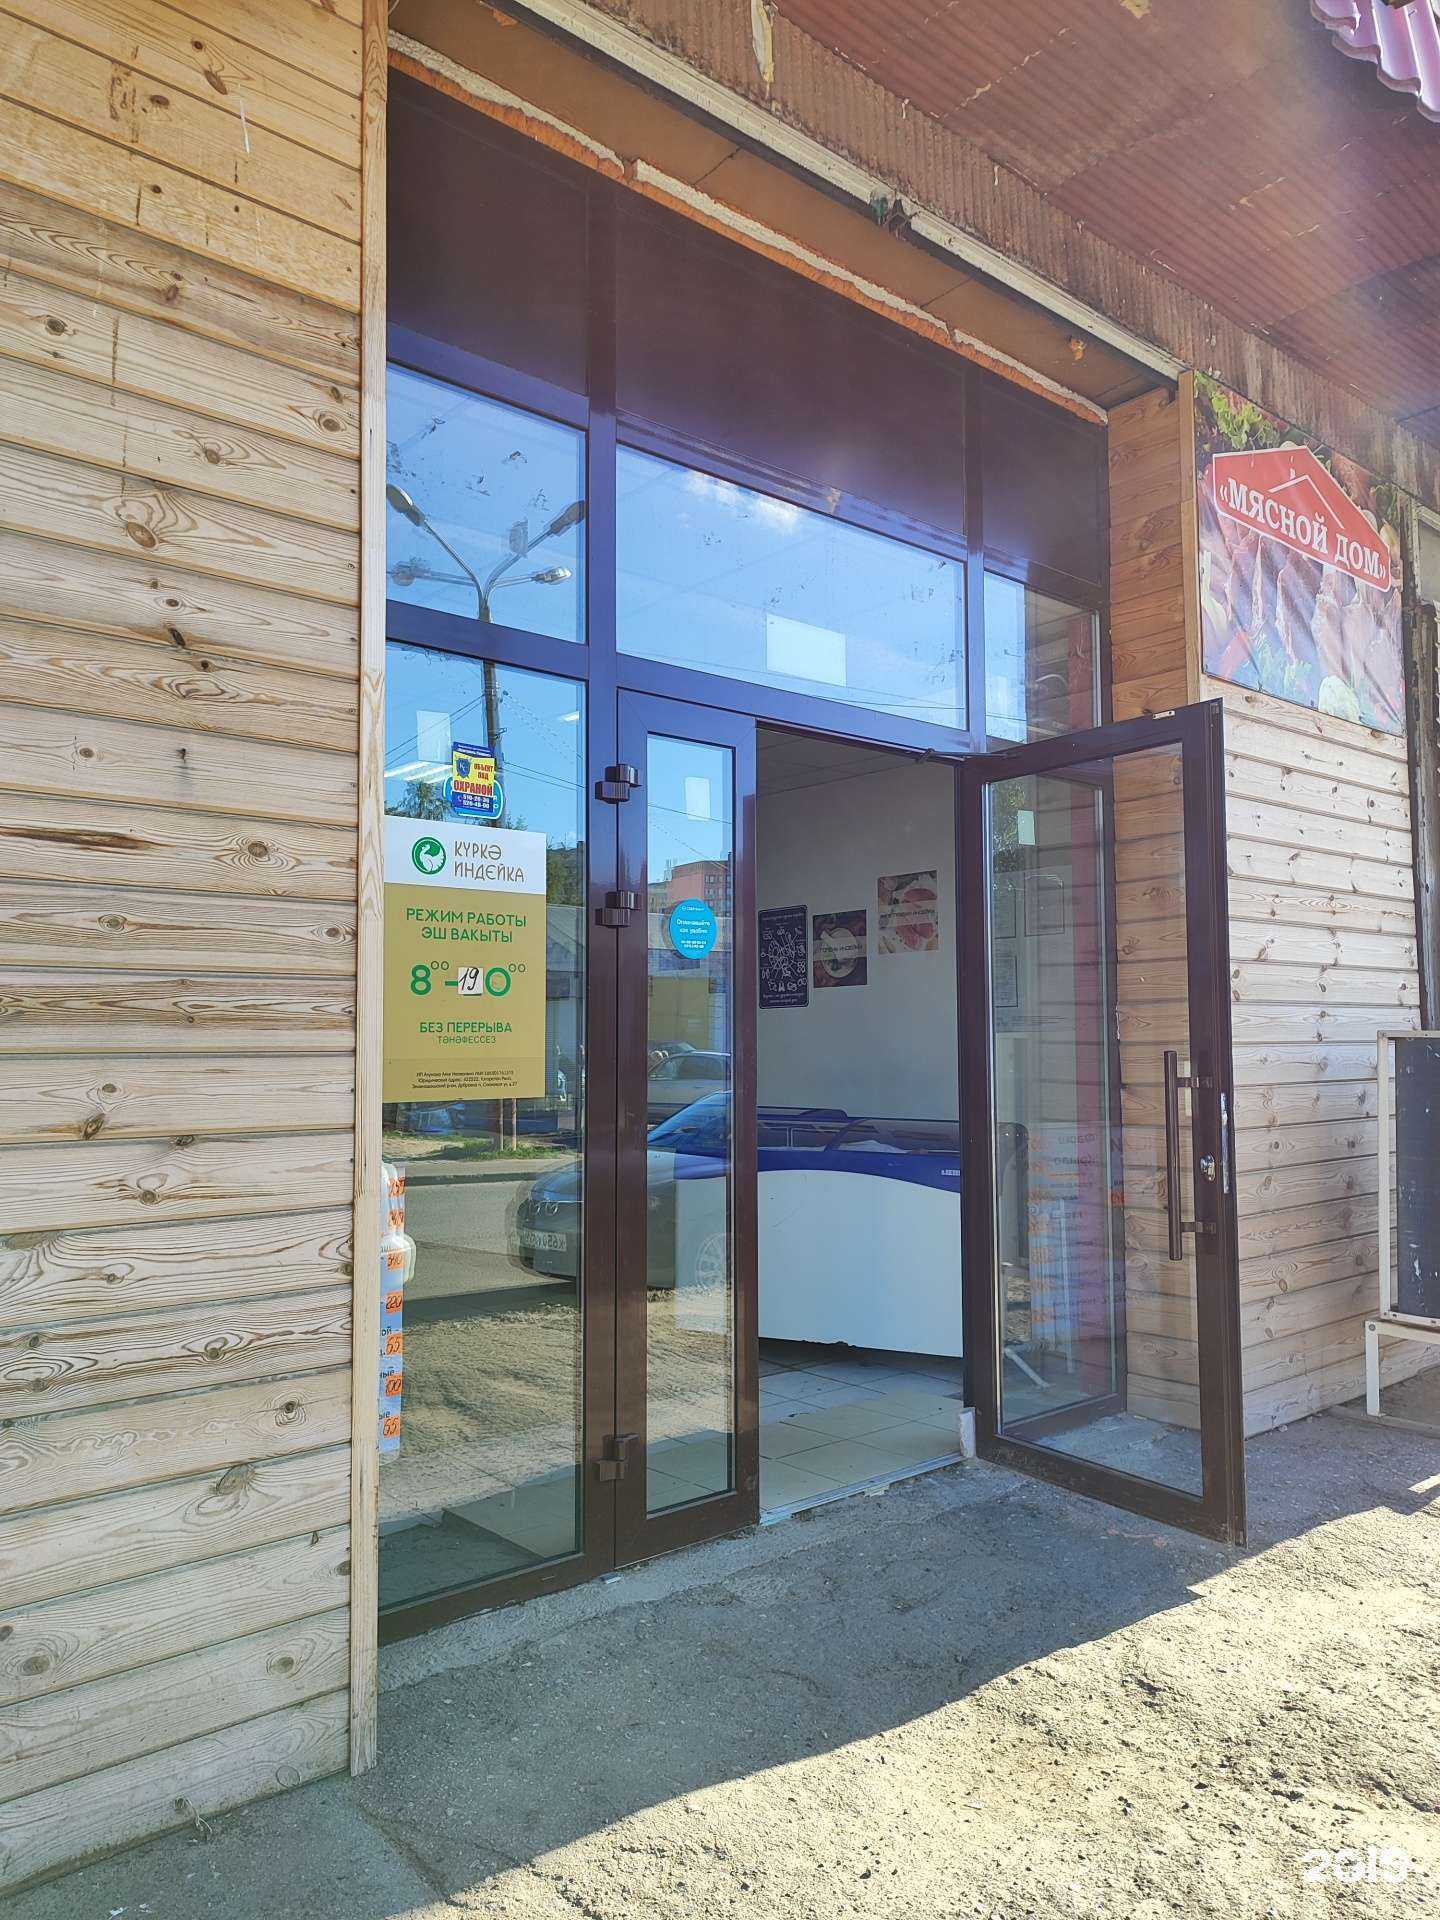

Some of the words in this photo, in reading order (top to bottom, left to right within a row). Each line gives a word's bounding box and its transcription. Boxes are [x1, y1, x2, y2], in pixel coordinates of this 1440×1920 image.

[1219, 477, 1329, 554] «МЯСНОЙ
[1335, 533, 1386, 580] ДОМ»
[453, 780, 493, 796] ОХРАНОЙ
[454, 861, 525, 883] ИНДЕЙКА
[406, 908, 464, 923] РЕЖИМ
[467, 912, 527, 927] РАБОТЫ
[421, 926, 446, 940] ЭШ
[451, 927, 513, 943] ВАКЫТЫ
[419, 1022, 443, 1033] БЕЗ
[447, 1022, 512, 1033] ПЕРЕРЫВА
[386, 1295, 402, 1310] 220
